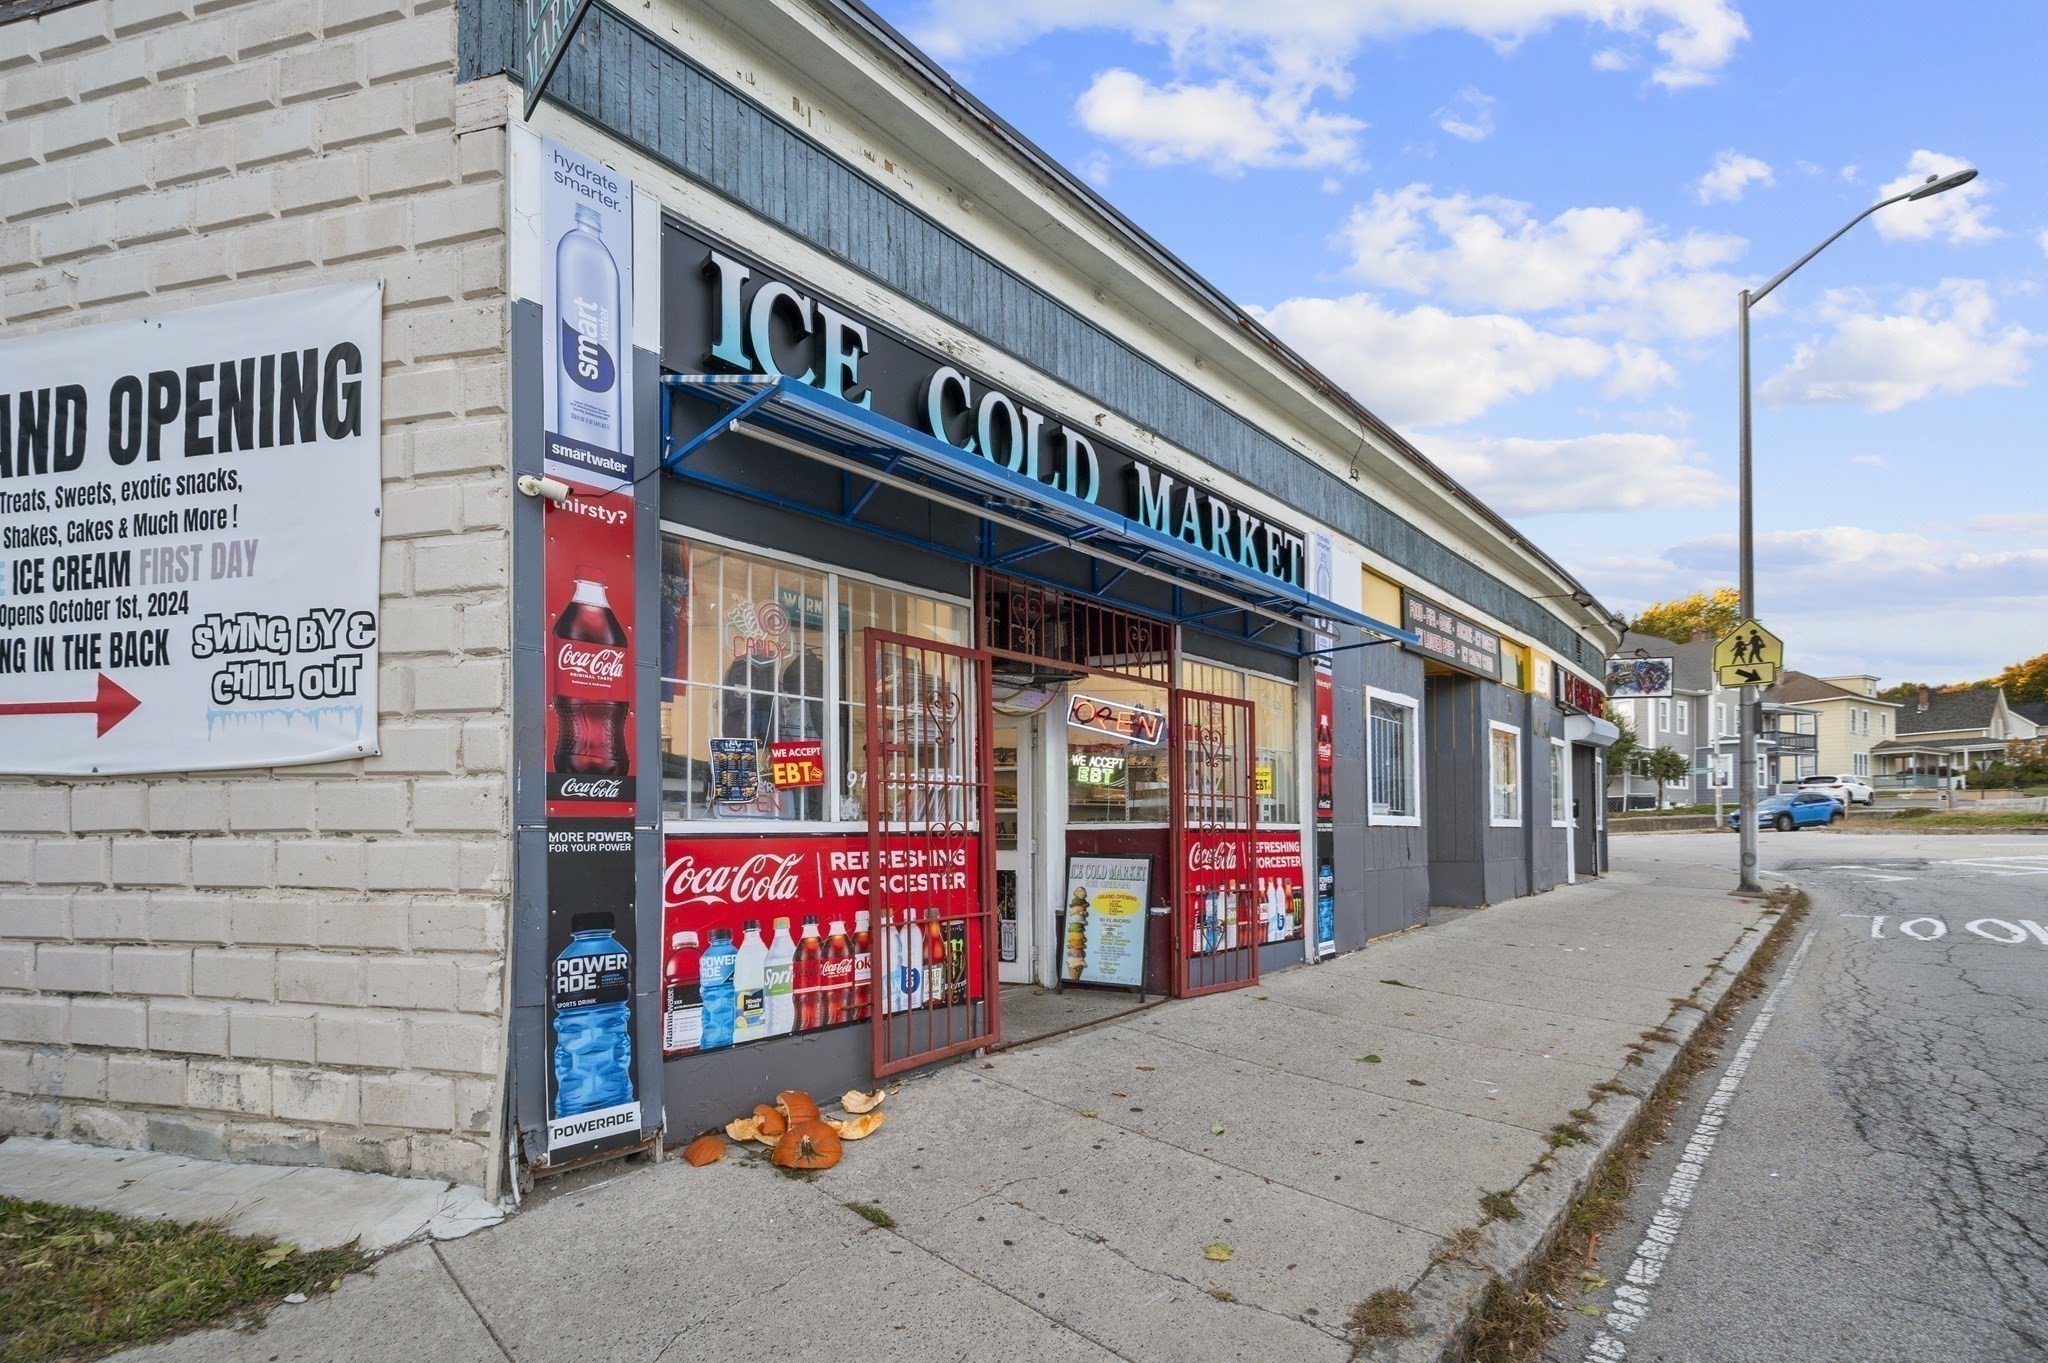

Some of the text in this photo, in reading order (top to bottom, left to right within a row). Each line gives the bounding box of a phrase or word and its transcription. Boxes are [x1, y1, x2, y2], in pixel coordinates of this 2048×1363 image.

[554, 149, 618, 194] hydrate
[554, 170, 622, 212] smarter.
[573, 296, 598, 380] smart
[599, 304, 609, 342] water
[108, 341, 362, 466] OPENING
[707, 250, 1305, 589] ICE COLD MARKET
[551, 442, 628, 473] smartwater
[0, 468, 242, 514] Treats, Sweets, exotic snacks,
[3, 524, 62, 549] Shakes,
[67, 516, 113, 543] Cakes
[118, 517, 128, 539] &
[133, 510, 178, 538] Much
[184, 507, 227, 533] More
[12, 558, 45, 596] ICE
[52, 550, 131, 593] CREAM
[139, 543, 203, 586] FIRST
[211, 538, 259, 580] DAY
[0, 590, 189, 631] Opens October 1st, 2024
[192, 608, 377, 660] SWING BY &
[733, 635, 788, 664] CANDY
[34, 635, 55, 673] IN
[62, 633, 101, 671] THE
[110, 628, 170, 668] BACK
[558, 643, 626, 678] Coca-Cola
[211, 653, 363, 705] CHILL OUT
[570, 672, 596, 680] ORIGINAL
[1074, 700, 1158, 739] OPEN
[772, 747, 821, 758] WE ACCEPT
[1072, 754, 1125, 770] WE ACCEPT
[560, 776, 624, 799] Coca-Cola
[773, 761, 812, 785] EBT
[1078, 766, 1114, 784] EBT
[1256, 780, 1268, 790] EBT
[548, 832, 584, 843] MORE
[549, 843, 632, 853] FOR YOUR POWER
[664, 849, 967, 907] Coca-Cola REFRESHING
[833, 873, 967, 897] WORCESTER
[1070, 863, 1147, 881] ICE COLD MARKET
[557, 953, 628, 978] POWER
[822, 958, 853, 977] Coca-Cola
[557, 973, 597, 994] ADE
[556, 998, 597, 1009] SPORTS DRINK
[666, 988, 675, 1049] vitaminwater
[553, 1111, 635, 1140] POWERADE
